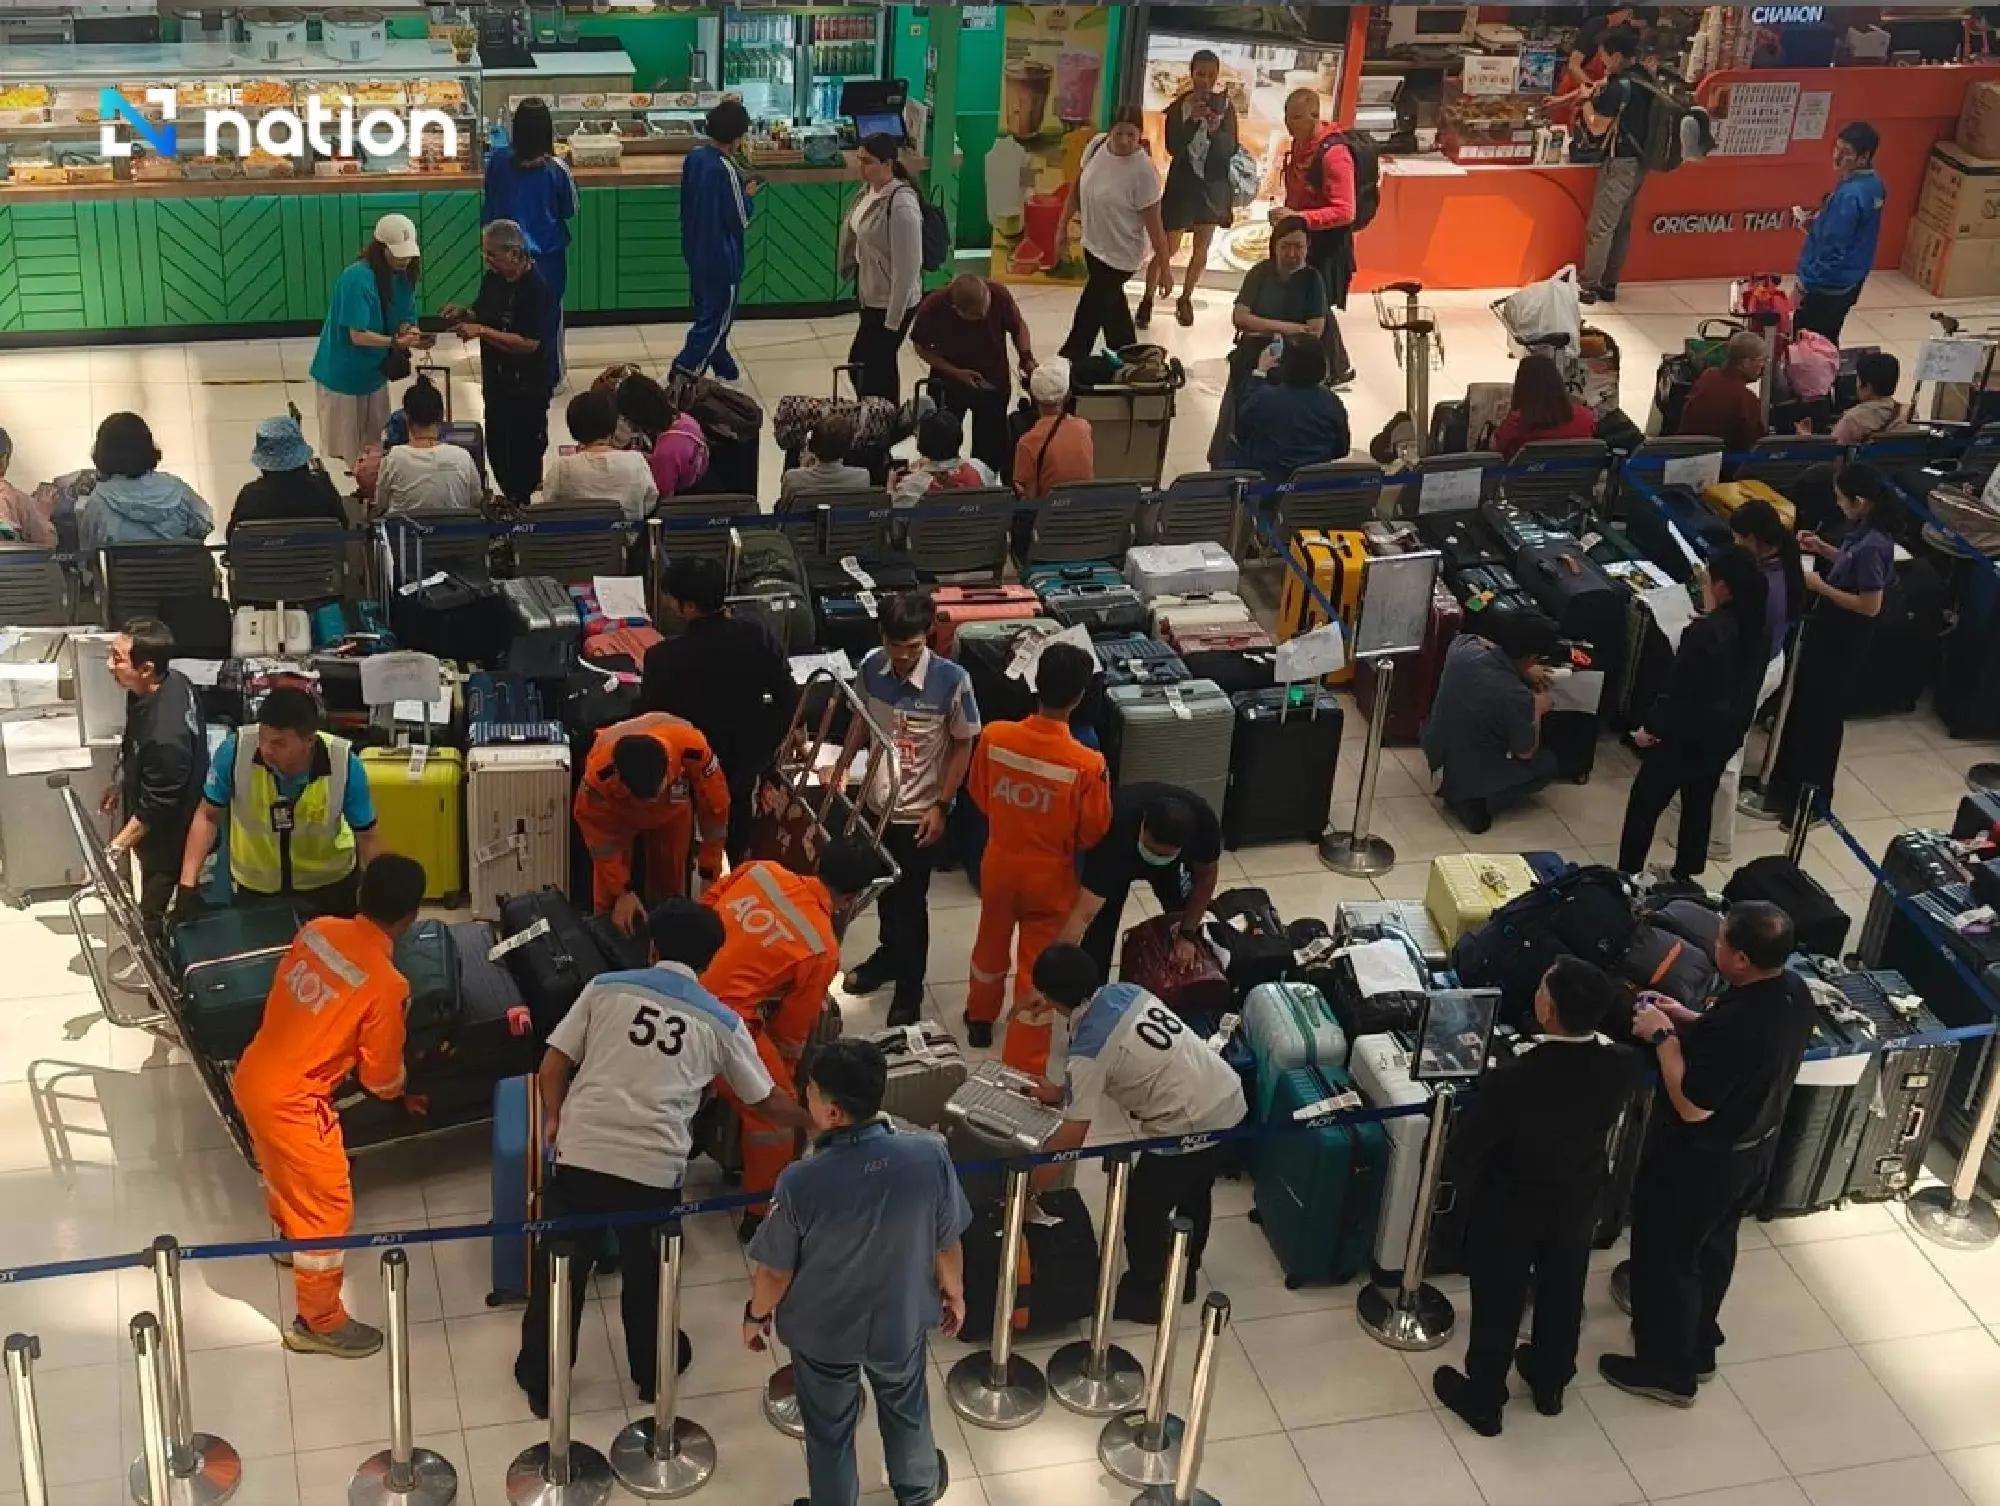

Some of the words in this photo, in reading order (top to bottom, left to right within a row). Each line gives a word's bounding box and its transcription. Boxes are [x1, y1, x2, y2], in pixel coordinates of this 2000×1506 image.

[1653, 213, 1736, 235] ORIGINAL
[1744, 211, 1784, 232] THAI
[992, 776, 1056, 814] AOT
[726, 895, 796, 948] AOT
[285, 960, 340, 1015] AOT
[628, 1004, 686, 1056] 53
[1136, 1007, 1183, 1050] 08
[1052, 1151, 1083, 1162] AOT
[370, 1234, 406, 1245] AOT
